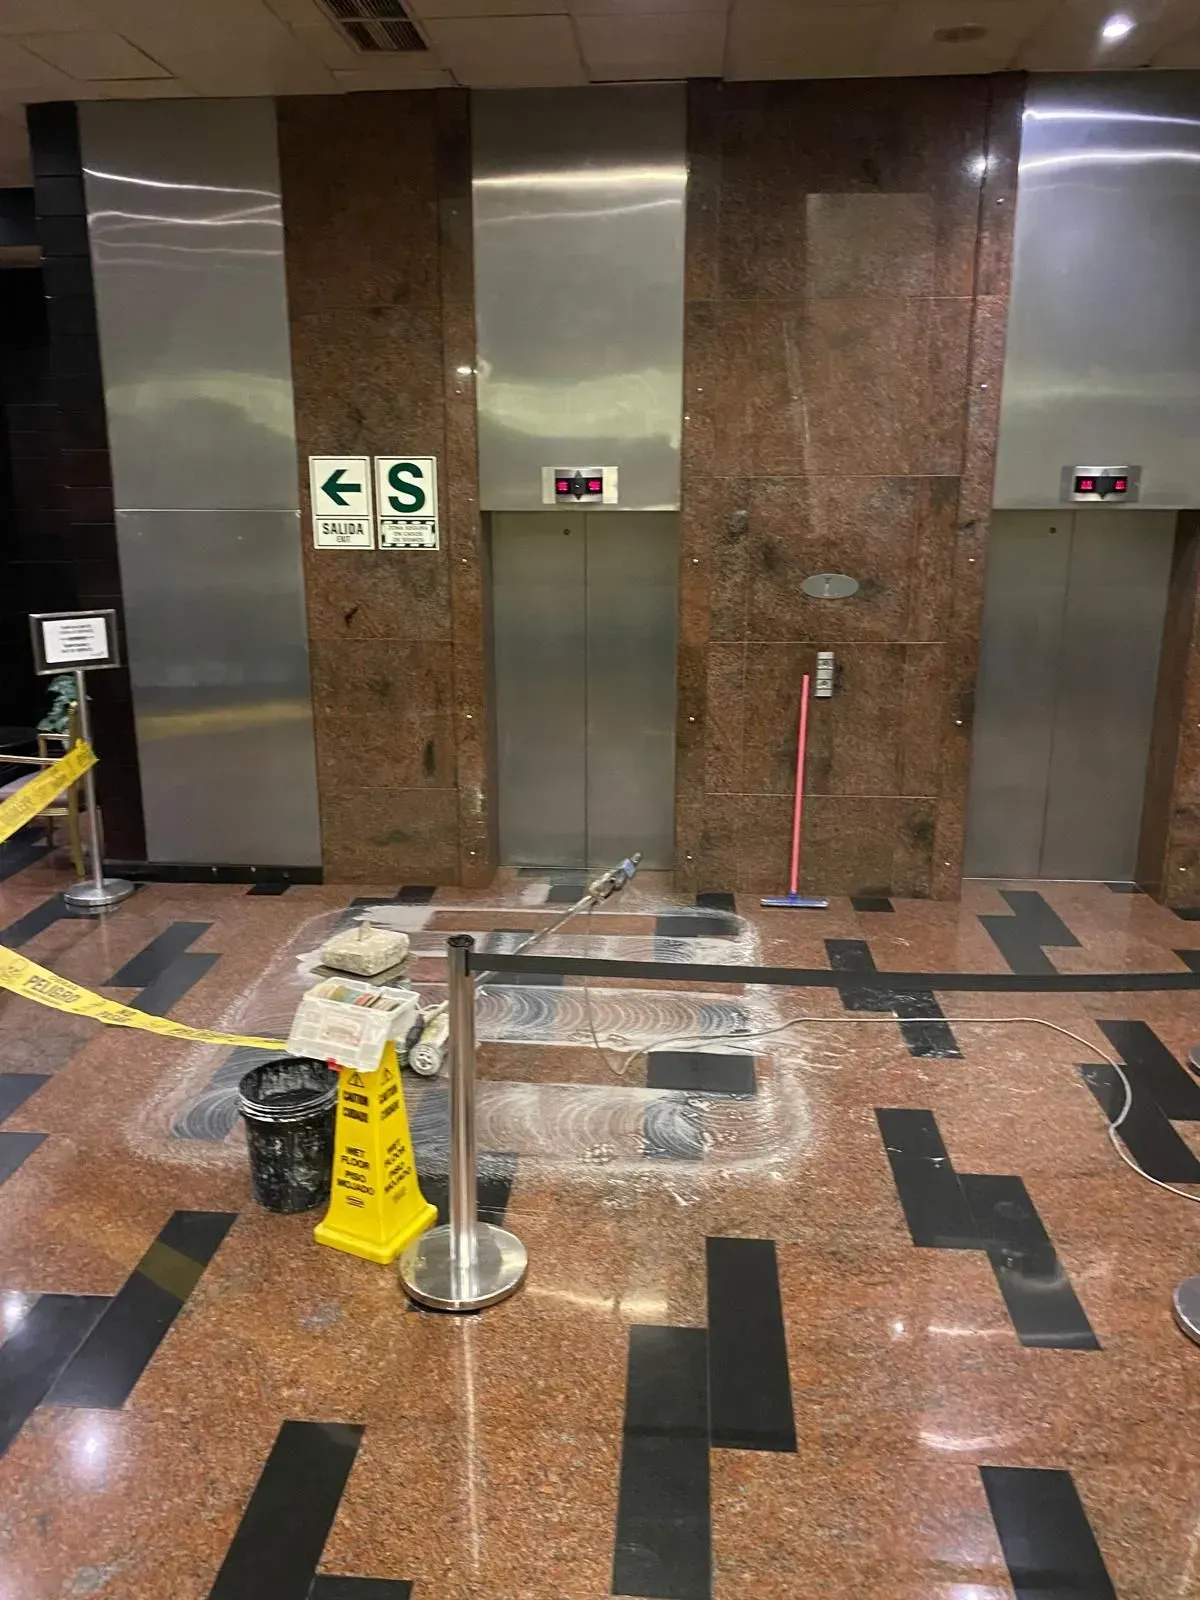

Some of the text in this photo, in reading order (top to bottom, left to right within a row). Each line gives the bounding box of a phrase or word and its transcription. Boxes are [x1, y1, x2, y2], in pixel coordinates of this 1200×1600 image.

[388, 462, 426, 513] S
[322, 523, 364, 535] SALIDA
[335, 535, 352, 543] EXIT
[22, 974, 81, 1004] PELIGRO
[346, 1147, 365, 1158] WET
[341, 1155, 370, 1170] FLOOR
[345, 1170, 367, 1183] PISO
[337, 1178, 376, 1196] MOJADO
